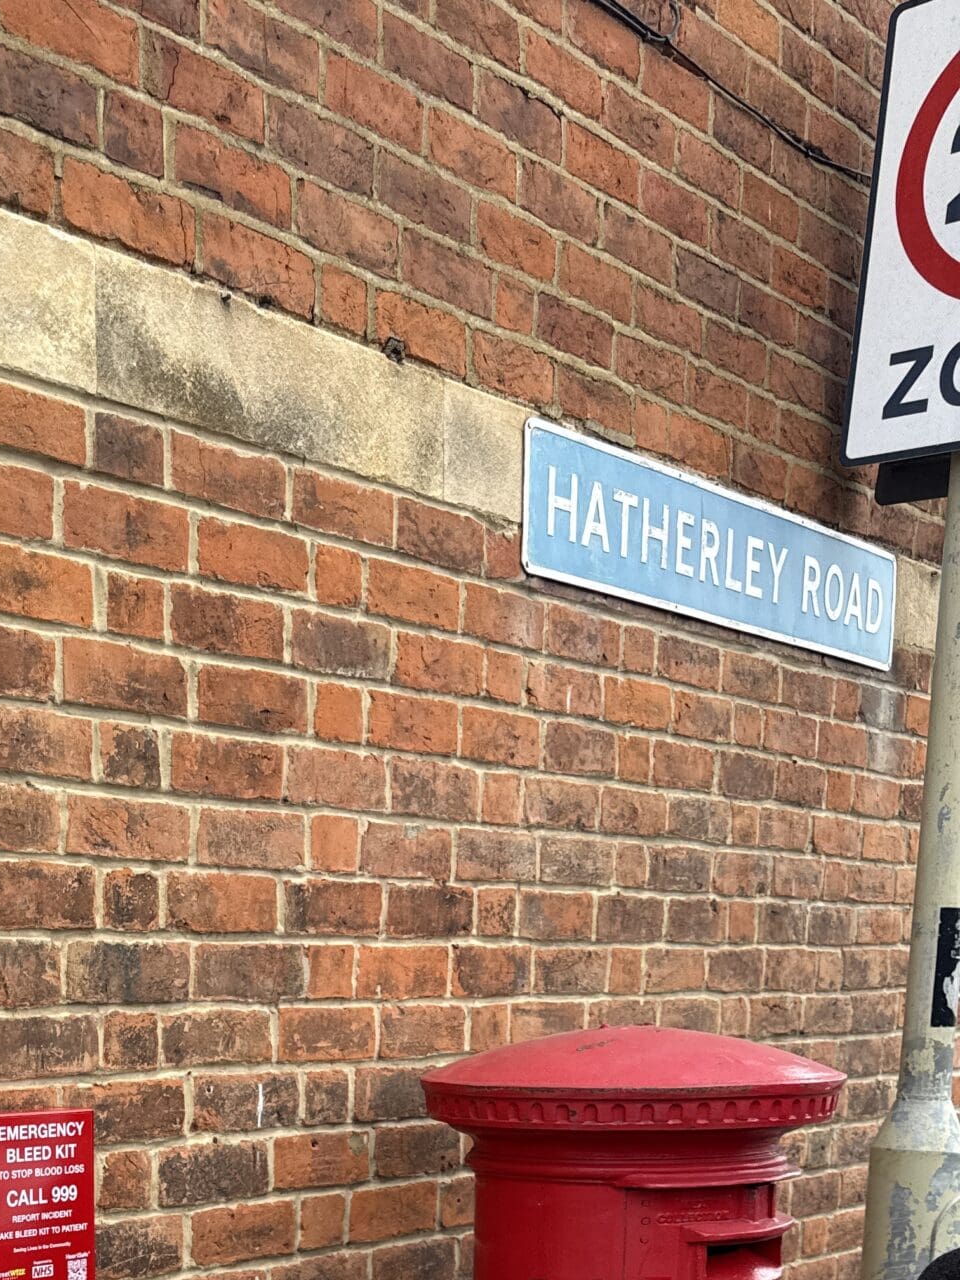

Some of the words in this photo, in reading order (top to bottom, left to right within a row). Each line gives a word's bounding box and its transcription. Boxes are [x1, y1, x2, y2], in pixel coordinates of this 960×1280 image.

[547, 463, 788, 604] HATHERLEY
[801, 555, 883, 634] ROAD
[6, 1146, 52, 1164] BLEED
[55, 1143, 77, 1159] KIT
[11, 1168, 33, 1179] STOP
[34, 1165, 63, 1178] BLOOD
[64, 1163, 85, 1175] LOSS
[6, 1187, 48, 1208] CALL
[51, 1184, 78, 1203] 999
[12, 1213, 40, 1223] REPORT
[41, 1209, 73, 1221] INCIDENT
[15, 1228, 37, 1239] BLEED
[38, 1226, 50, 1236] KIT
[51, 1225, 61, 1235] TO
[61, 1222, 89, 1233] PATIENT
[32, 1264, 54, 1279] NHS
